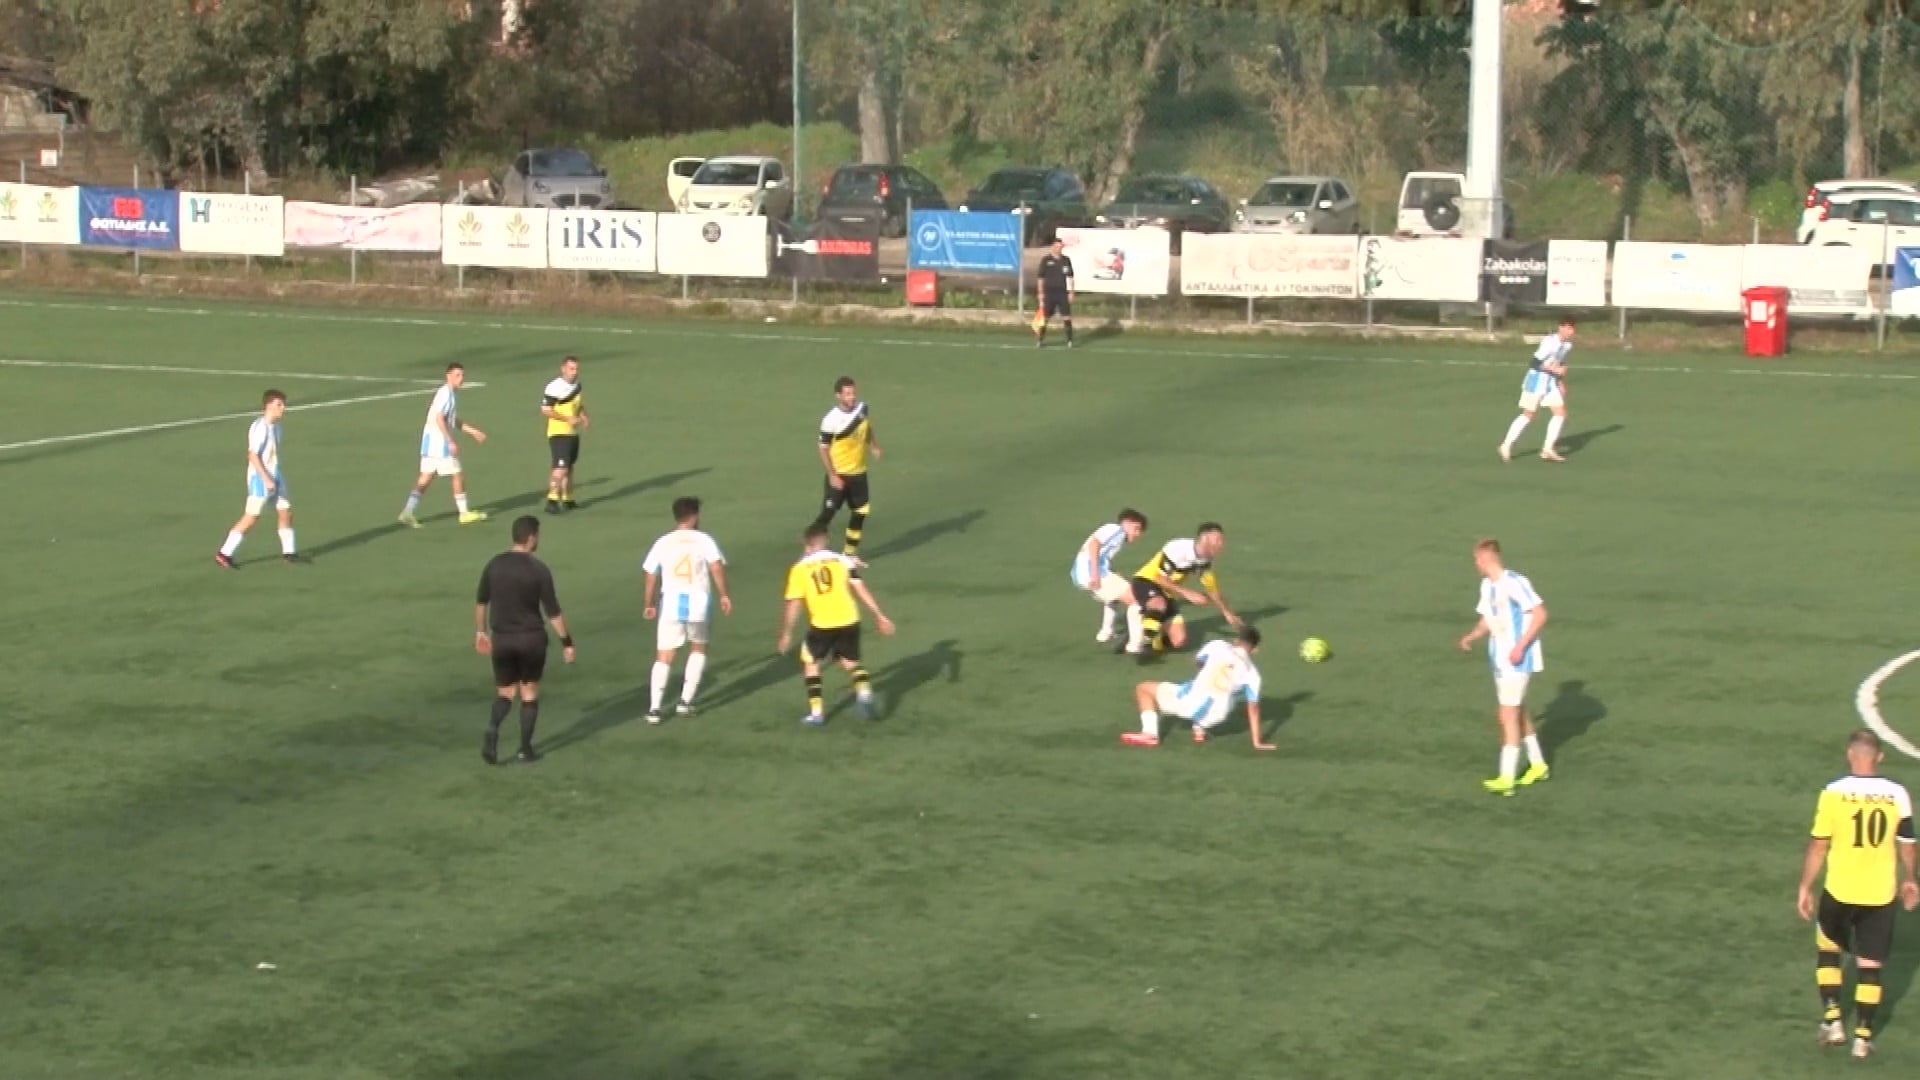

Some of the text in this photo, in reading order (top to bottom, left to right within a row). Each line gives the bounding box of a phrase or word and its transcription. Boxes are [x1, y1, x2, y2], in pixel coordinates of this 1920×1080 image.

[674, 552, 693, 584] 4
[811, 565, 834, 595] 19
[1851, 807, 1888, 848] 10
